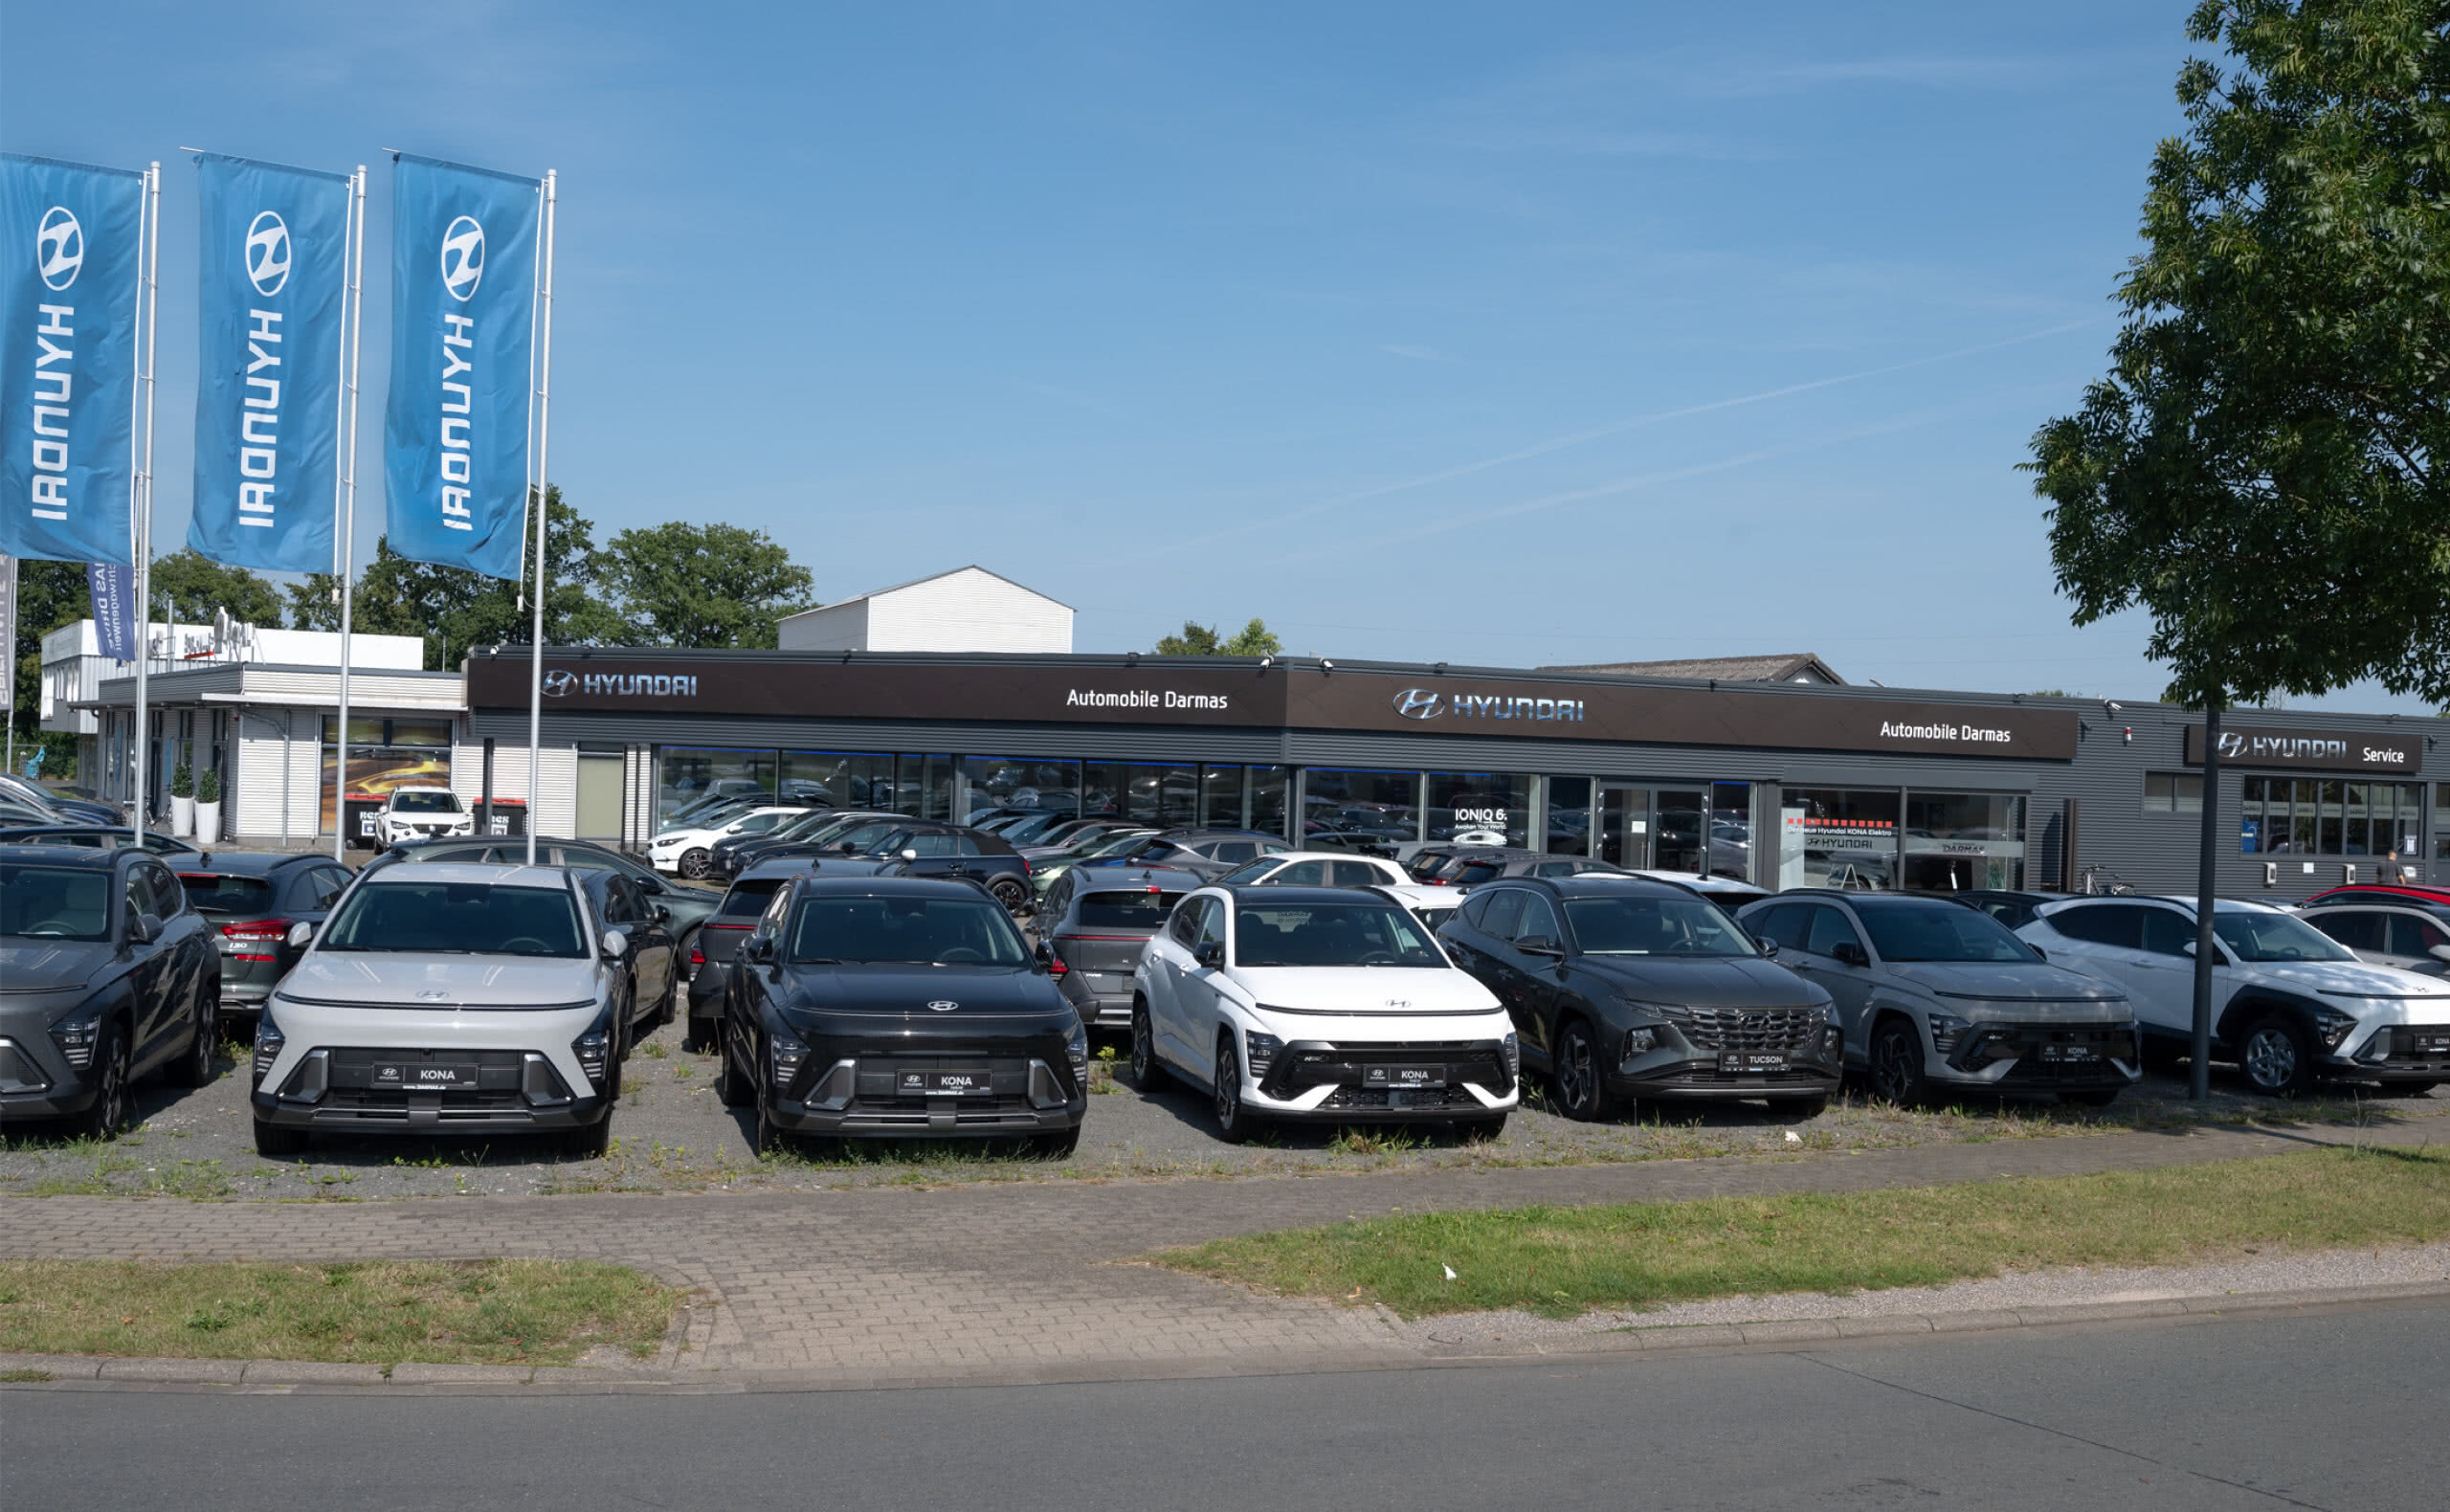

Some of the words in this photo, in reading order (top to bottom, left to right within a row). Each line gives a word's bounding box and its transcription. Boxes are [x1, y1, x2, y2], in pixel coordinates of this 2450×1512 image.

[584, 674, 697, 698] HYUNDAI
[1066, 688, 1159, 708] Automobile
[1165, 690, 1228, 710] Darmas
[1455, 695, 1584, 723] HYUNDAI
[1881, 721, 1957, 740] Automobile
[1962, 724, 2011, 743] Darmas
[2253, 736, 2347, 759] HYUNDAI
[2363, 746, 2404, 764] Service
[1455, 808, 1493, 823] IONIQ
[1818, 827, 1846, 835] Hyundai
[1822, 838, 1872, 849] HYUNDAI
[1749, 1056, 1783, 1064] TUCSON
[420, 1070, 456, 1080] KONA
[941, 1076, 972, 1086] KONA
[1401, 1070, 1429, 1079] KONA
